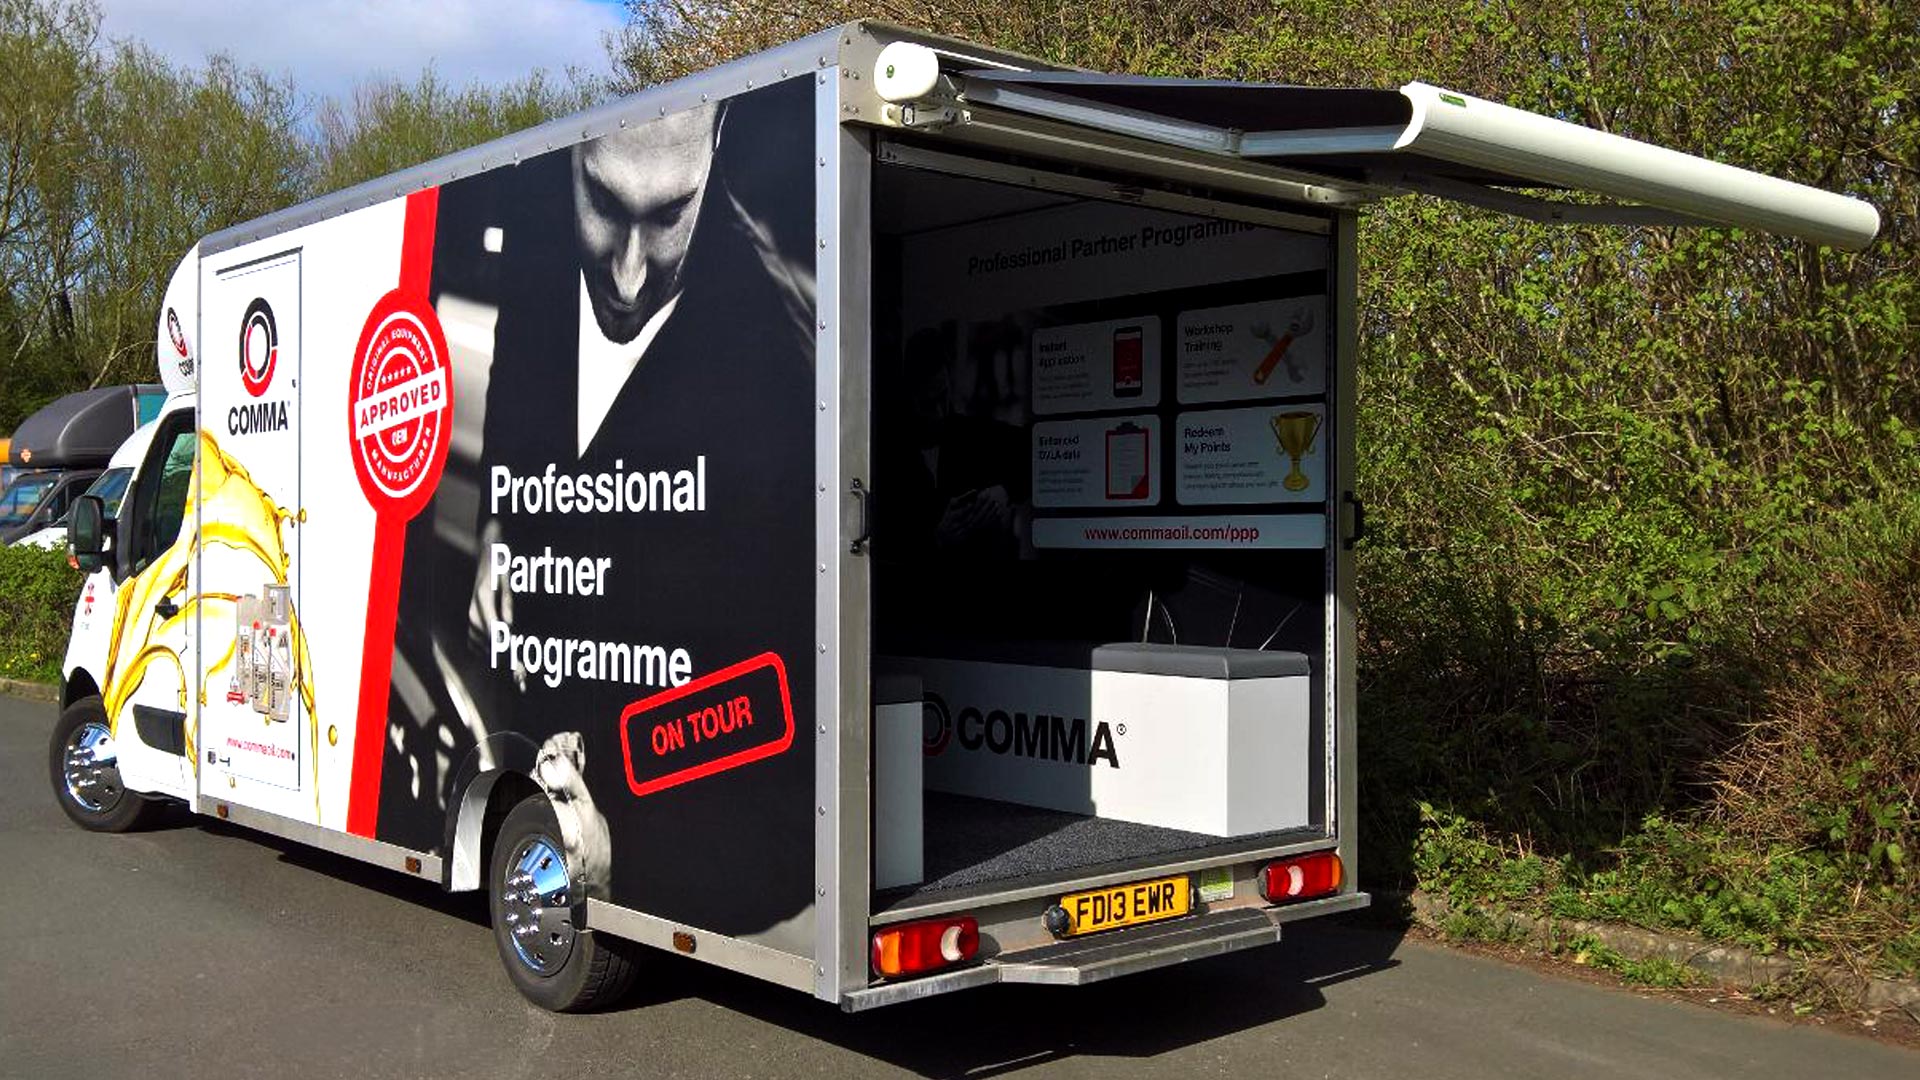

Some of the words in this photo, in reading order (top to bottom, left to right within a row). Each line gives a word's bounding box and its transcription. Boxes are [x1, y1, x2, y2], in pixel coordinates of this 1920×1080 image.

[967, 242, 1067, 275] Professional
[1071, 231, 1137, 260] Partner
[1184, 324, 1233, 336] Workshop
[366, 335, 389, 390] ORIGINAL
[391, 328, 429, 364] EQUIPMENT
[228, 400, 288, 436] COMMA
[360, 379, 441, 429] APPROVED
[372, 426, 431, 482] MANUFACTURER
[1184, 427, 1224, 438] Redeem
[1184, 442, 1199, 455] My
[1200, 442, 1231, 453] Points
[490, 455, 706, 514] Professional
[1084, 524, 1260, 543] www.commaoil.com/ppp
[490, 542, 612, 596] Partner
[490, 619, 692, 689] Programme
[651, 718, 686, 756] ON
[687, 696, 753, 744] TOUR
[956, 705, 1120, 769] COMMA
[1076, 892, 1126, 928] FD13
[1133, 883, 1175, 917] EWR
